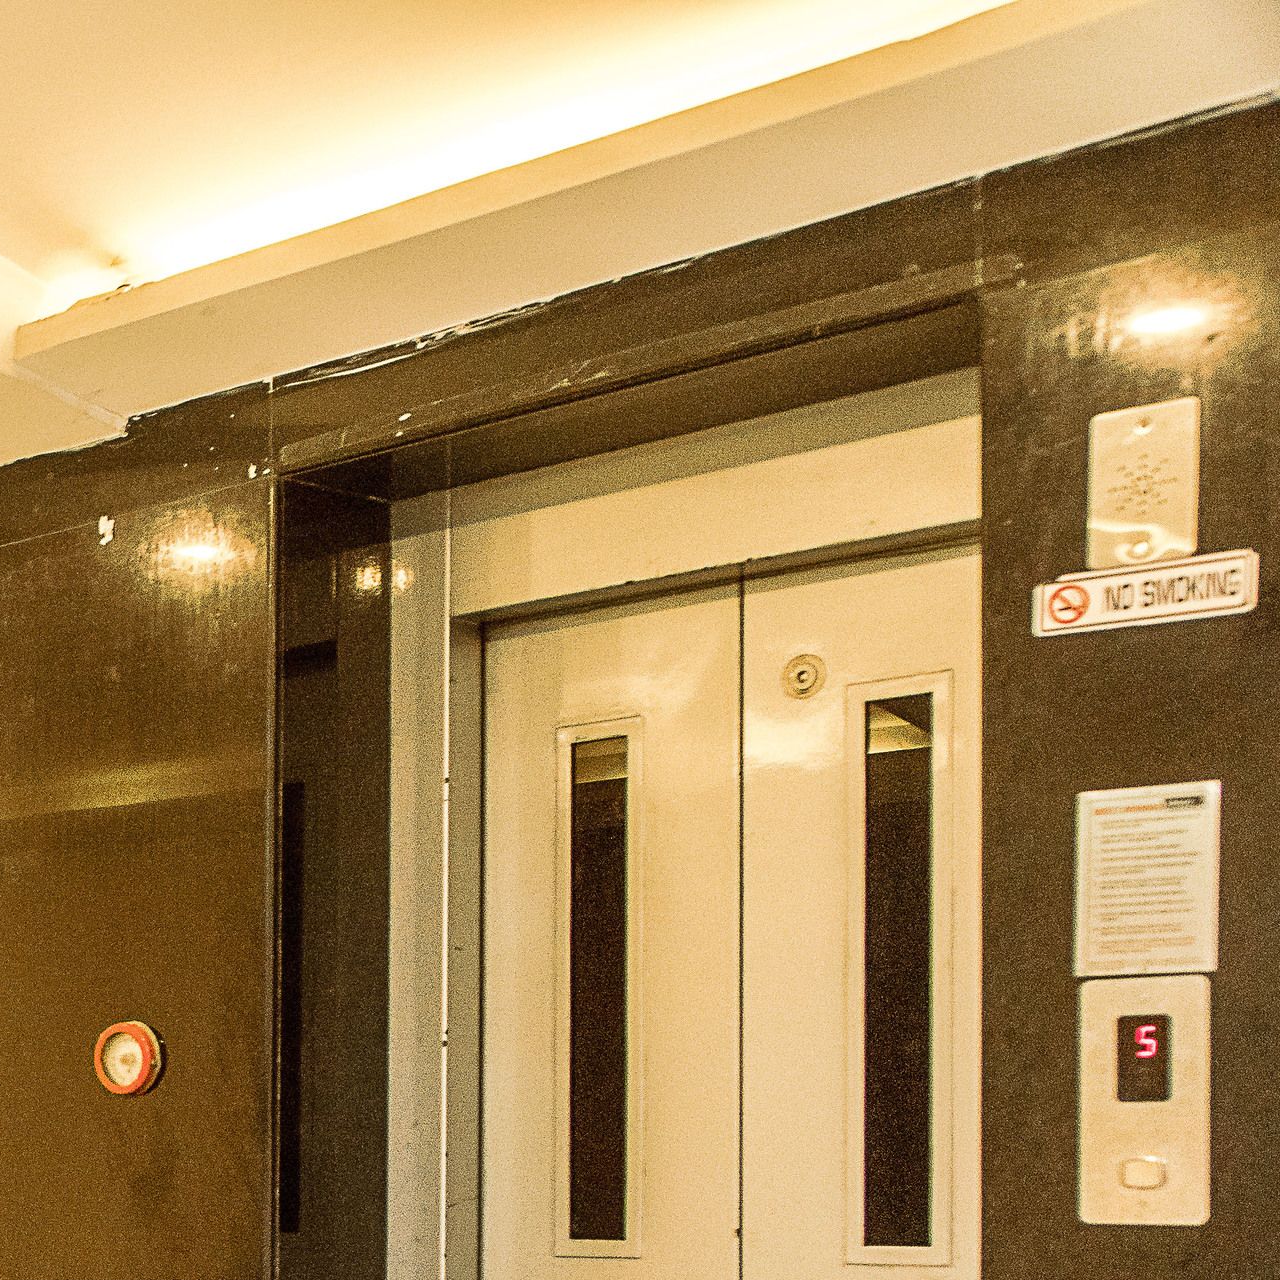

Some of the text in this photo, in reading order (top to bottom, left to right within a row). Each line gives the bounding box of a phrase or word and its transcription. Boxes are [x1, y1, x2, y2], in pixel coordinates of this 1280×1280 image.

[1103, 568, 1240, 613] NO SMOKING
[1135, 1023, 1159, 1059] 5
